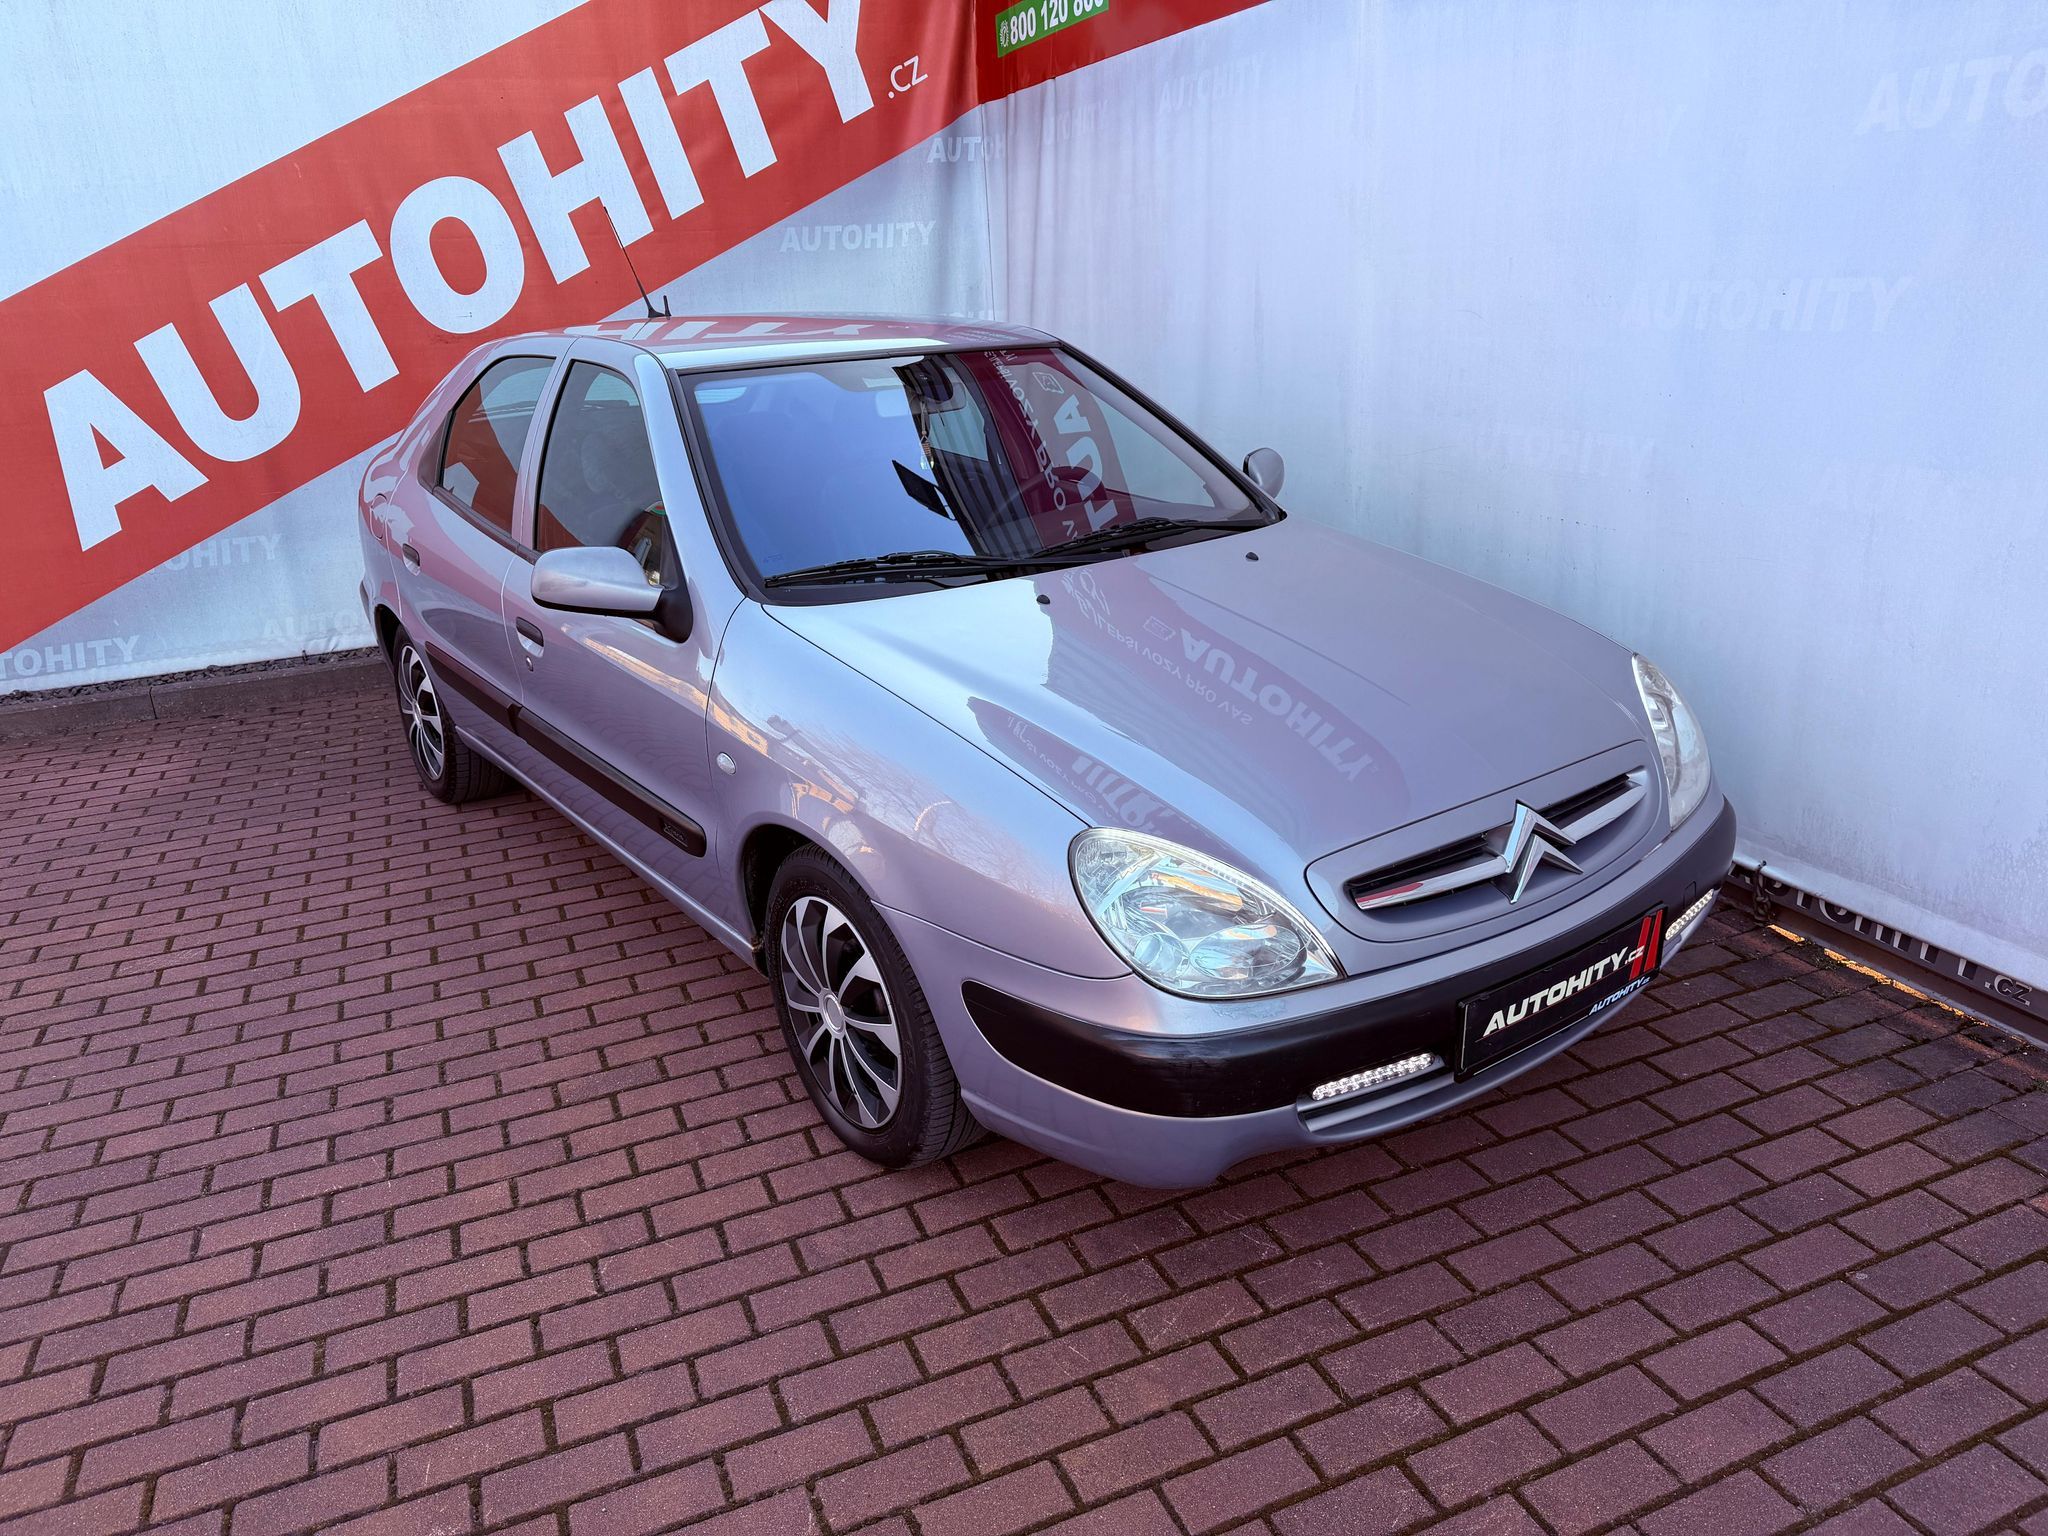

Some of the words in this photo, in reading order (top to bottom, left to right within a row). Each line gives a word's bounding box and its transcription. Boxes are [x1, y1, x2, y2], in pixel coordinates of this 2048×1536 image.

[1010, 6, 1036, 45] 800
[780, 221, 935, 253] AUTOHITY
[1620, 275, 1914, 334] AUTOHITY
